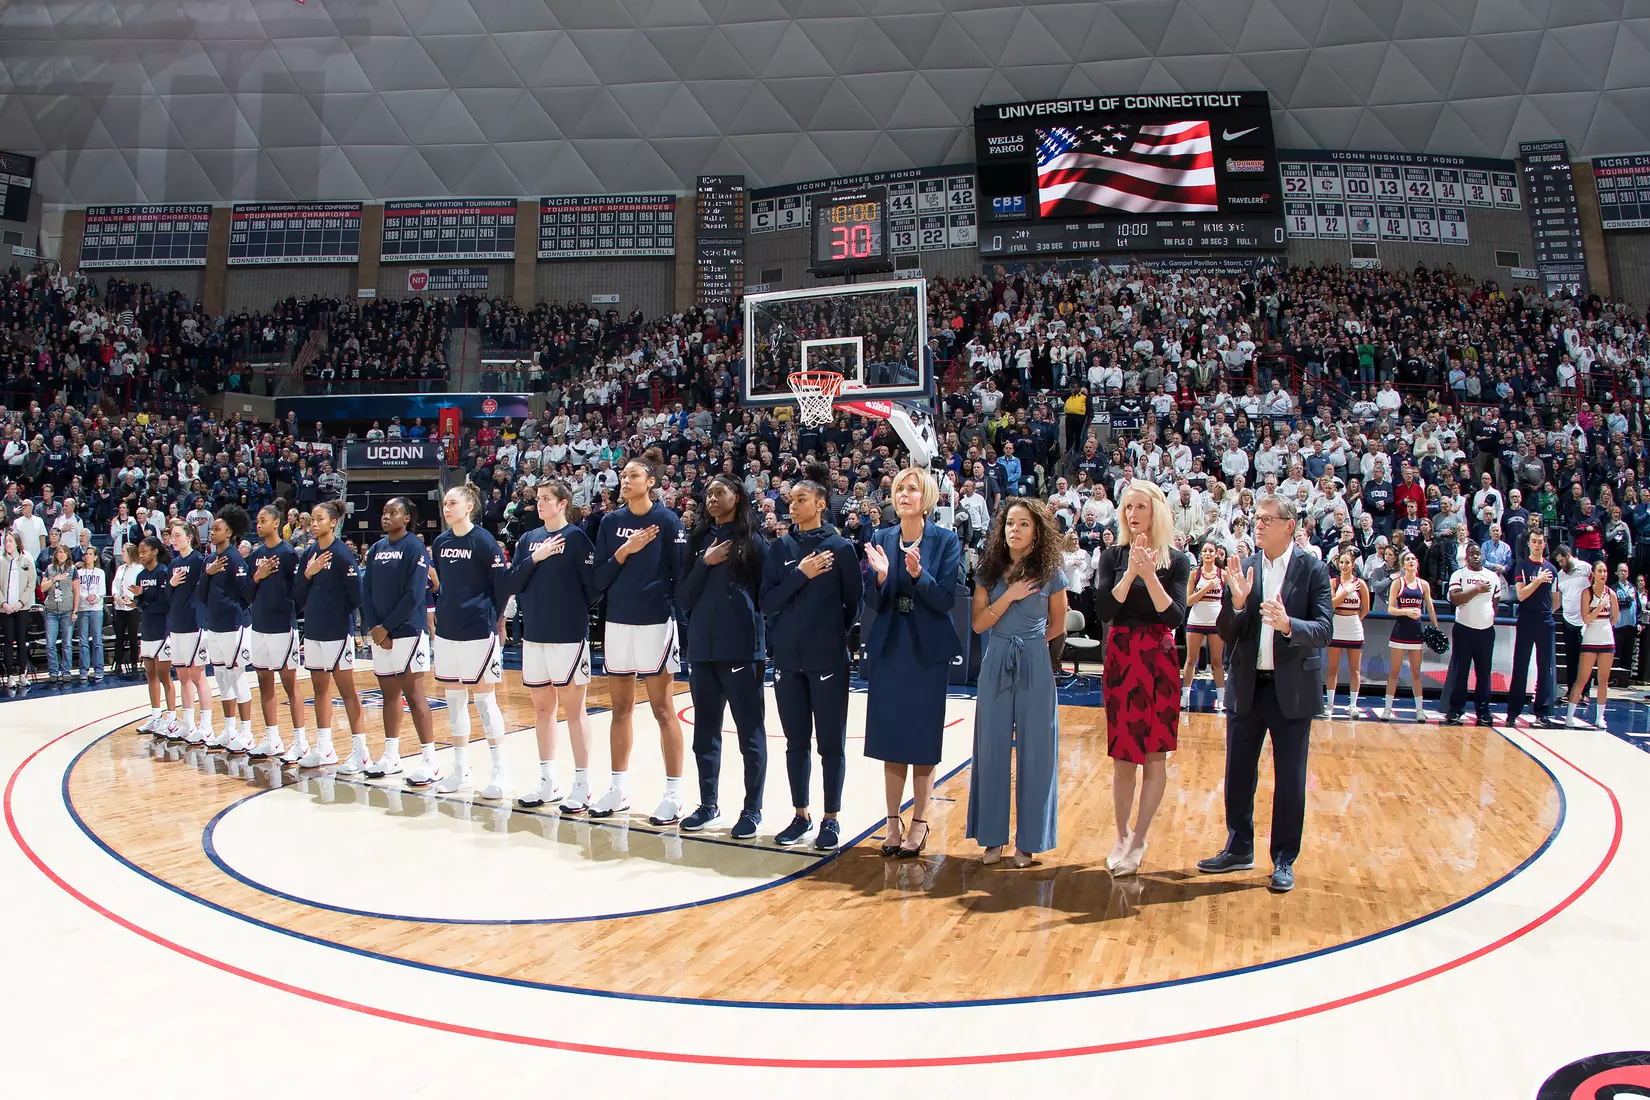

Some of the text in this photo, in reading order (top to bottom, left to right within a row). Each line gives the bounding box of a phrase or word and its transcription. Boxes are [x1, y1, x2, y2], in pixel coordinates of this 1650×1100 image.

[999, 95, 1241, 118] UNIVERSITY OF CONNECTICUT
[988, 135, 1024, 145] WELLS
[989, 144, 1024, 154] FARGO
[1600, 158, 1630, 167] NCAA
[797, 182, 826, 191] UCONN
[830, 176, 869, 186] HUSKIES
[1286, 179, 1513, 202] 52 00 13 42 34 32 50
[1620, 192, 1635, 202] 2011
[892, 190, 972, 210] 44 42
[992, 196, 1022, 207] CBS
[543, 213, 614, 223] 1951 1954 1957
[757, 210, 793, 226] C 9
[831, 202, 877, 223] 10:00
[345, 219, 359, 228] 2011
[405, 218, 419, 226] 1974
[424, 217, 437, 226] 1975
[1295, 217, 1457, 237] 15 22 42 13 3
[1118, 223, 1147, 236] 10:00
[1274, 228, 1283, 242] 0
[832, 224, 871, 260] 30
[895, 230, 942, 246] 13 22
[993, 236, 1002, 250] 0
[367, 446, 423, 459] UCONN
[440, 549, 471, 559] UCONN
[529, 542, 566, 553] UCN
[375, 551, 403, 560] UCONN
[1631, 637, 1640, 677] TRASH
